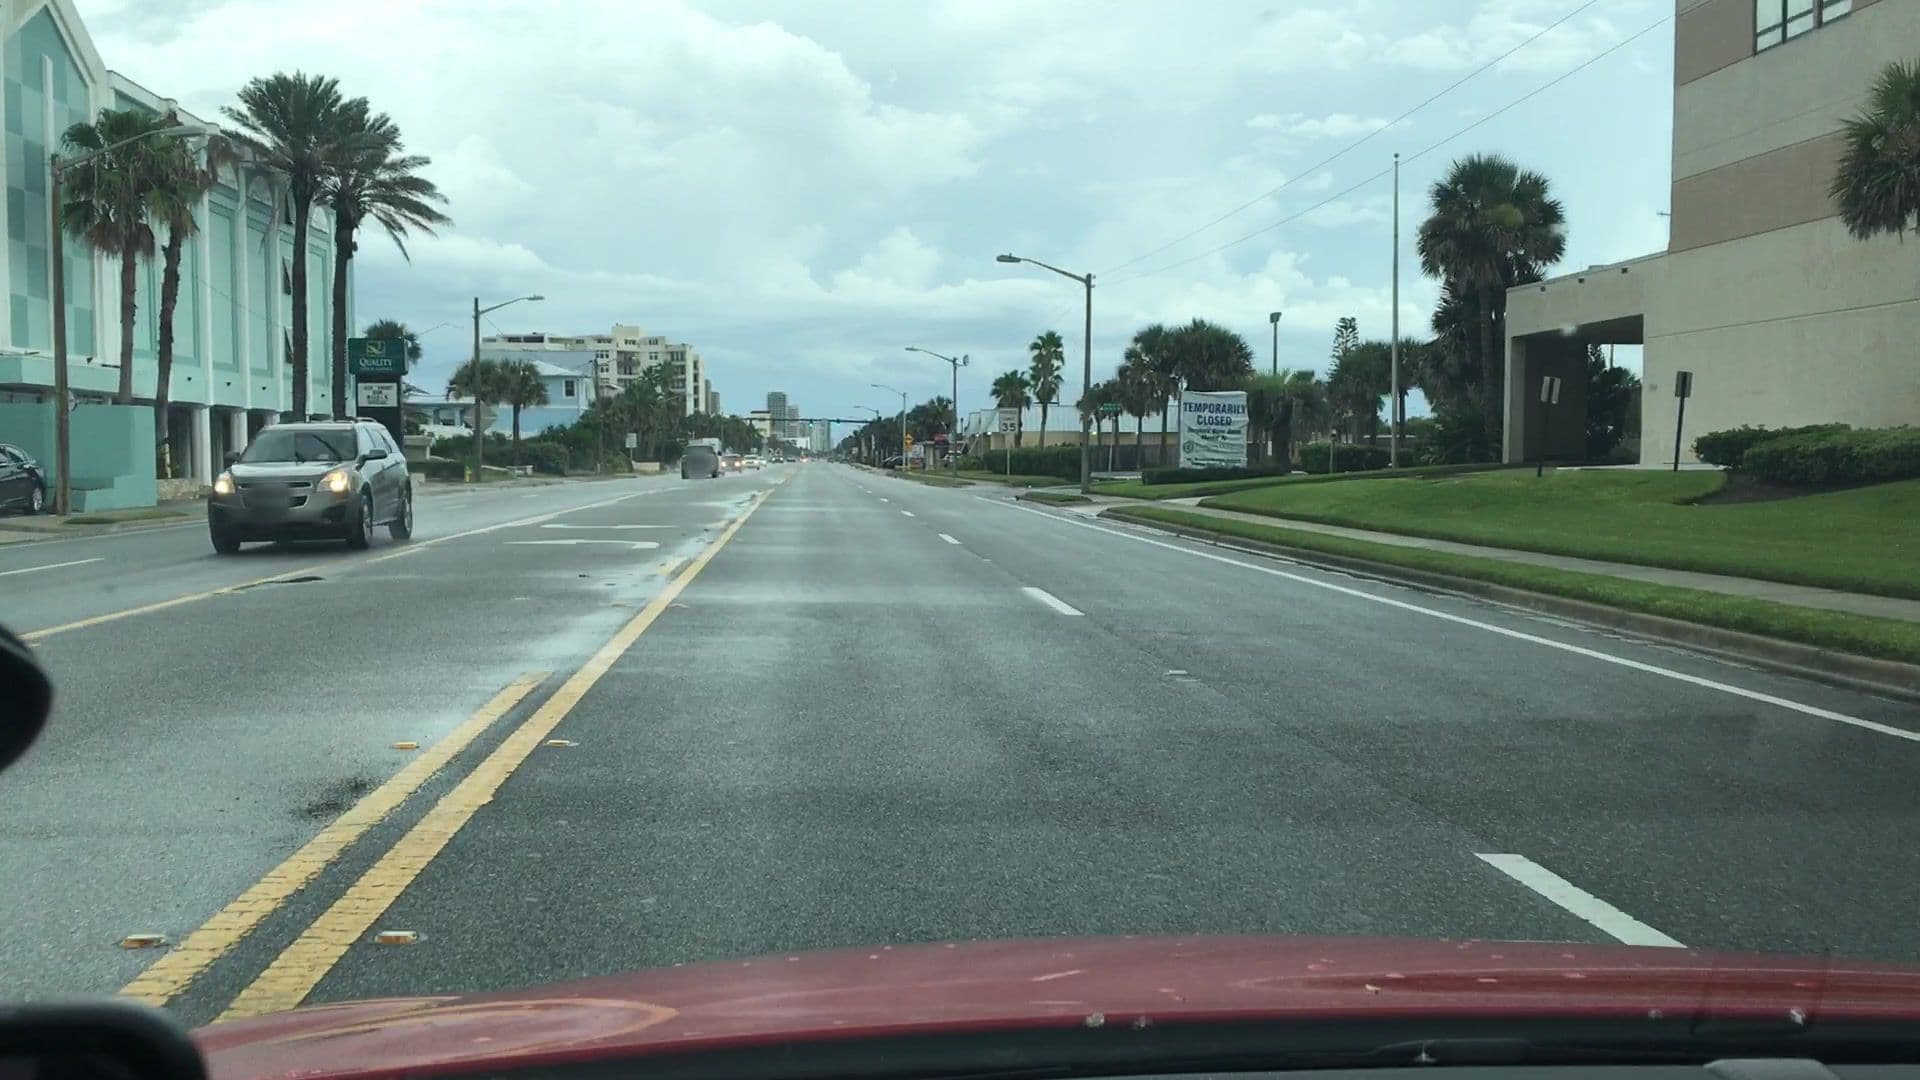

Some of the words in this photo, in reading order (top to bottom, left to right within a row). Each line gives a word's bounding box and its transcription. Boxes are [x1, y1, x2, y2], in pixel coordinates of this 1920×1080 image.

[359, 358, 392, 367] QUALITY
[1183, 402, 1246, 414] TEMPORARILY
[1197, 415, 1232, 426] CLOSED
[1001, 422, 1017, 432] 35
